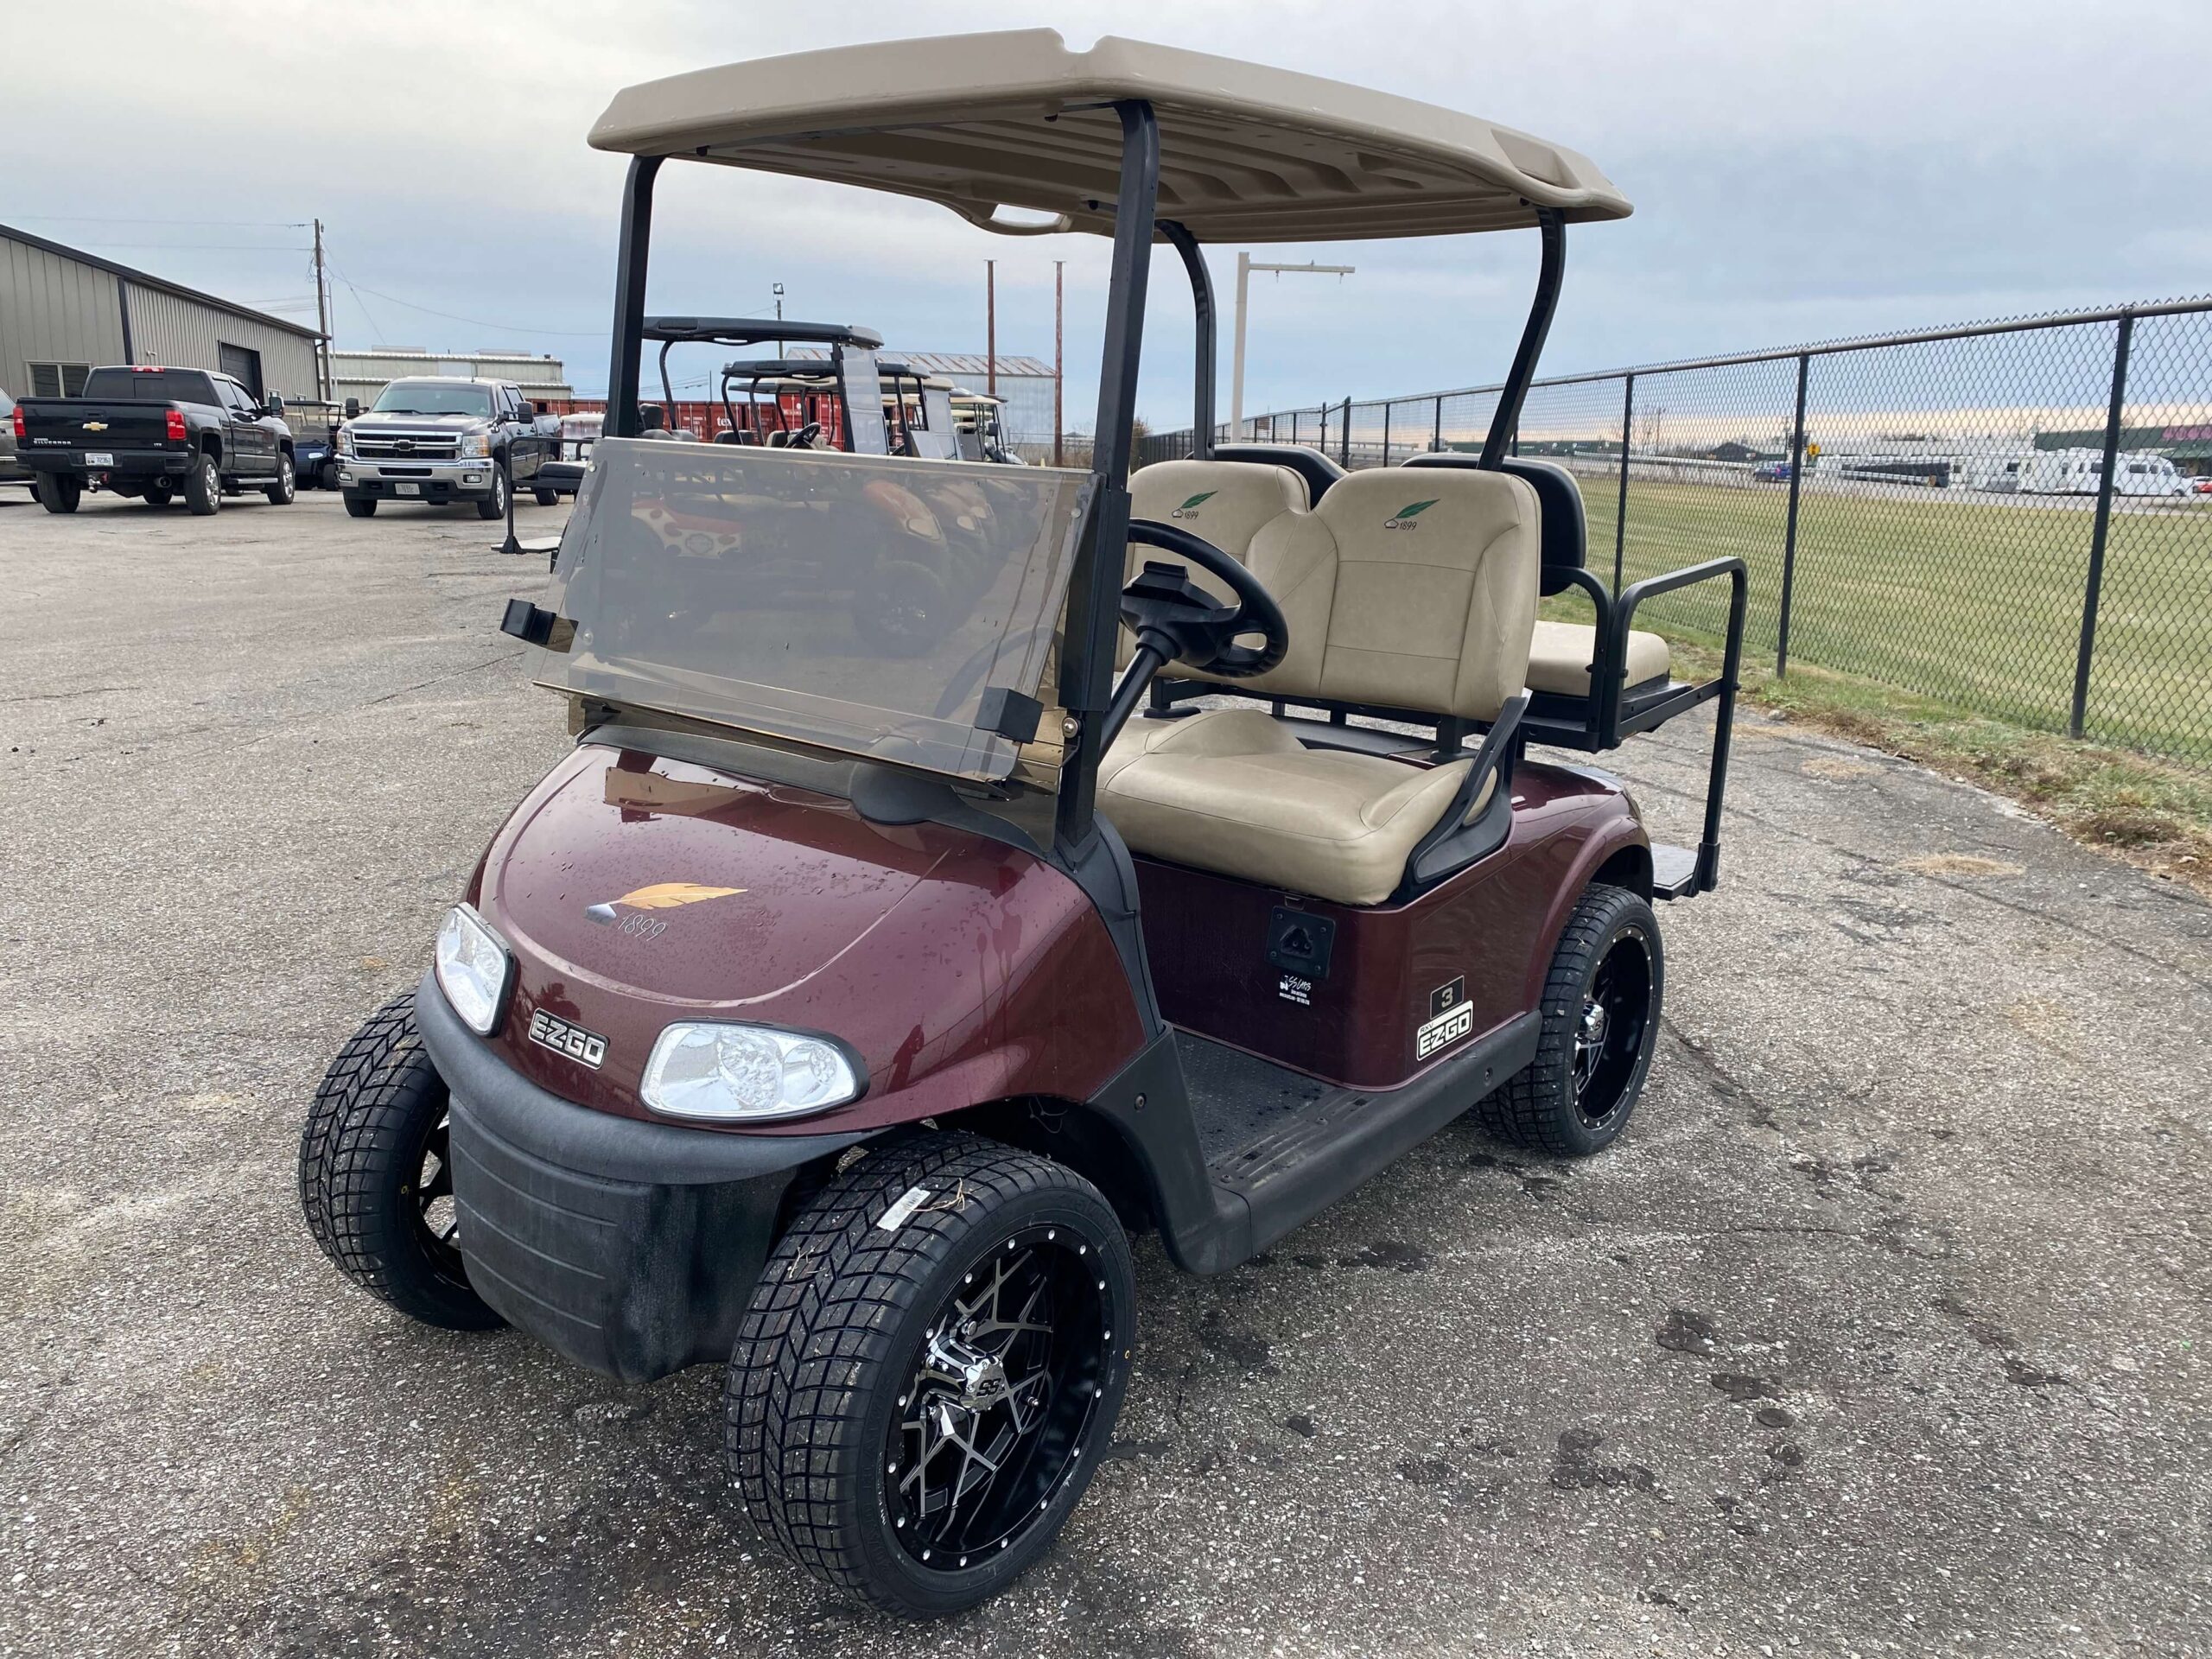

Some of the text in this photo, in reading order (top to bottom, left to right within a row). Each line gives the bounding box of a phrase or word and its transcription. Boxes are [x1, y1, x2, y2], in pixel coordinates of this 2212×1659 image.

[1184, 511, 1199, 520] 1899
[1400, 521, 1417, 531] 1899
[618, 912, 668, 942] 1899
[1441, 987, 1453, 1008] 3
[1419, 1011, 1471, 1057] EZGO
[1420, 1022, 1434, 1034] RXV
[531, 1013, 606, 1065] EZGO
[976, 1377, 1001, 1397] SS
